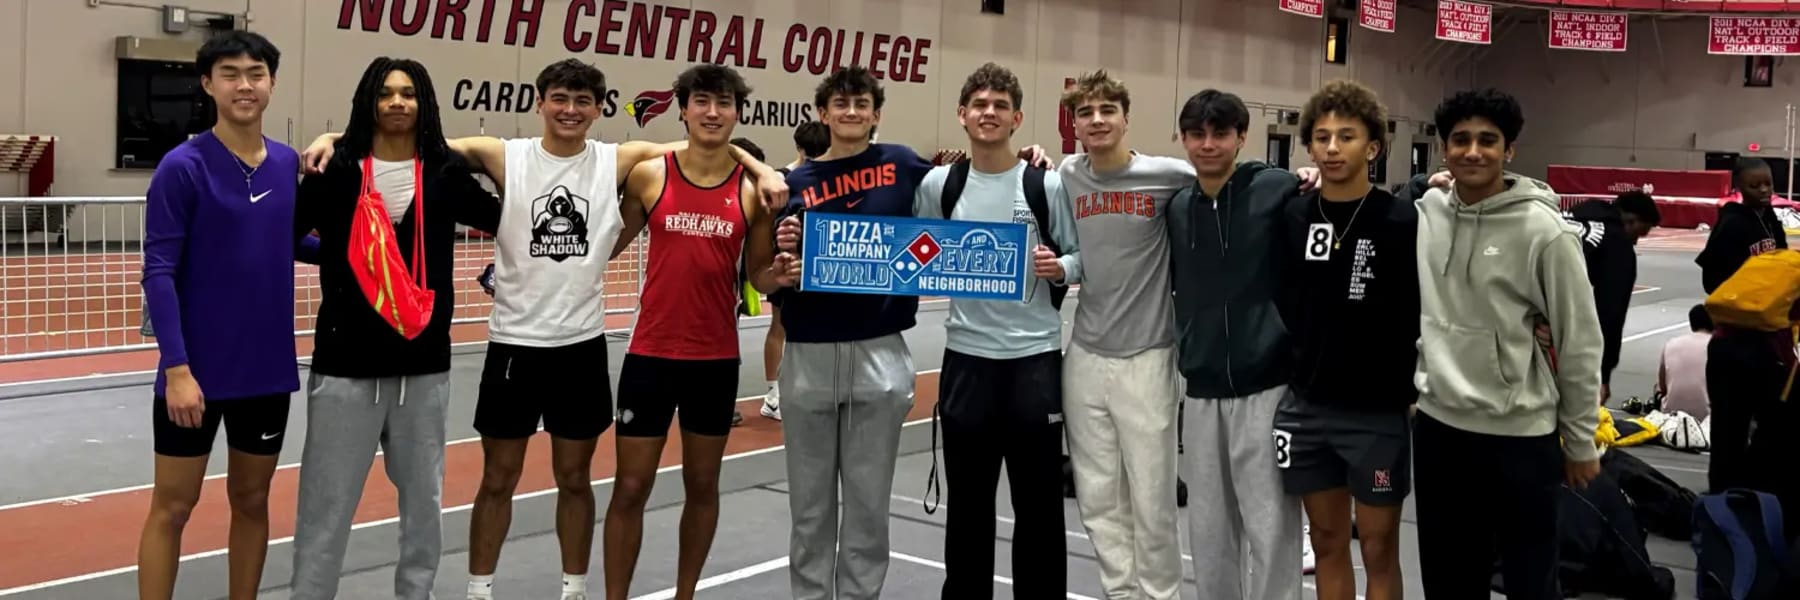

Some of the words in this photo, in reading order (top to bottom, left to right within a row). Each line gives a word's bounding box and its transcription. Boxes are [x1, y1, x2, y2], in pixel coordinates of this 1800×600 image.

[1572, 13, 1595, 22] NCAA
[1737, 19, 1766, 27] NCAA
[1441, 19, 1462, 29] TRACK
[1557, 21, 1582, 30] NAT'L
[1586, 23, 1620, 31] INDOOR
[1555, 30, 1583, 39] TRACK
[1595, 31, 1622, 40] FIELD
[1747, 28, 1799, 36] OUTDOOR
[337, 0, 545, 48] NORTH
[563, 0, 767, 69] CENTRAL
[782, 23, 931, 83] COLLEGE
[1562, 39, 1613, 48] CHAMPIONS
[1765, 36, 1797, 44] FIELD
[1724, 44, 1787, 53] CHAMPIONS
[802, 163, 896, 208] ILLINOIS
[1075, 191, 1156, 220] ILLINOIS
[665, 215, 733, 236] REDHAWKS
[829, 220, 882, 243] PIZZA
[540, 234, 579, 244] WHITE
[972, 235, 987, 245] AND
[1310, 228, 1329, 257] 8
[531, 243, 587, 255] SHADOW
[828, 242, 891, 259] COMPANY
[942, 248, 1013, 273] EVERY
[820, 261, 889, 286] WORLD
[919, 276, 1016, 294] NEIGHBORHOOD
[1276, 435, 1288, 464] 8
